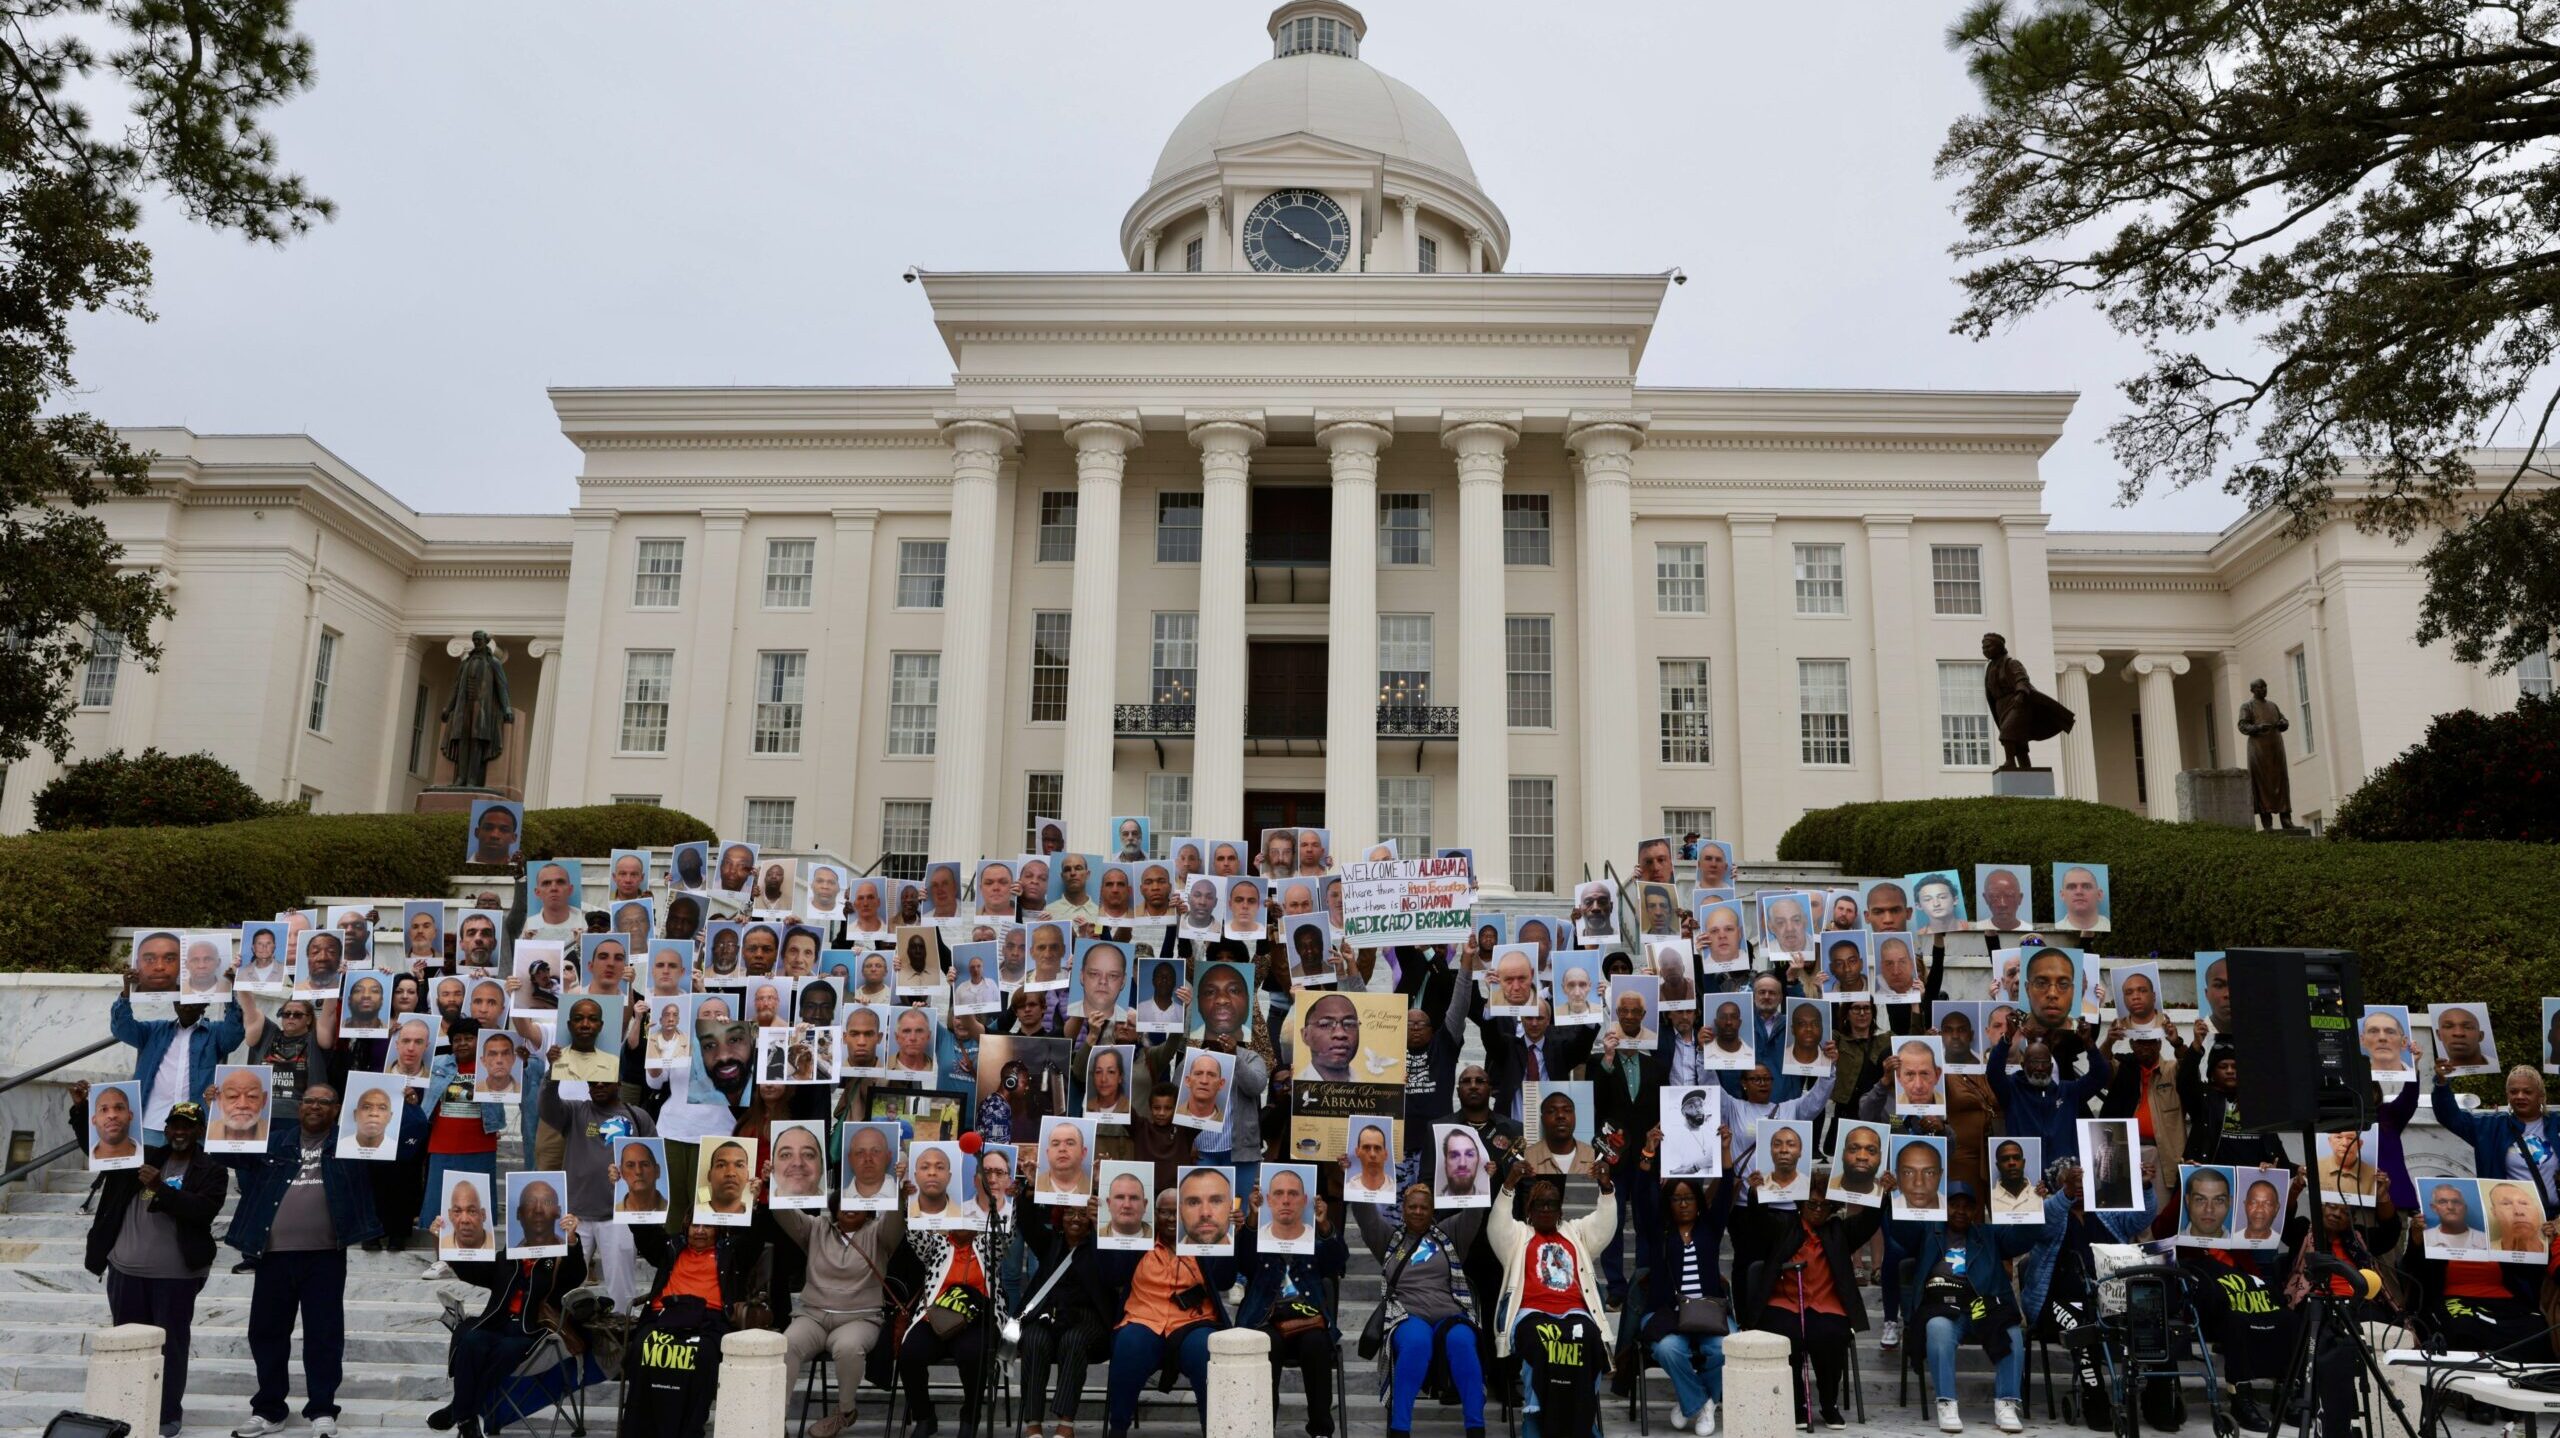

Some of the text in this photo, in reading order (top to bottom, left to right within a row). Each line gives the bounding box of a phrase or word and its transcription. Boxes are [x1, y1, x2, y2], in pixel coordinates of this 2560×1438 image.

[1341, 858, 1467, 881] WELCOME TO ALABAMA
[1400, 883, 1407, 893] is
[1390, 901, 1398, 910] is
[1420, 894, 1453, 910] DAMN
[1344, 908, 1471, 936] MEDICAID EXPANSION
[1378, 1009, 1402, 1022] Loving
[1367, 1021, 1398, 1033] Memory
[272, 1071, 294, 1080] BAMA
[272, 1079, 294, 1087] UTION
[1320, 1084, 1356, 1096] Roderick
[1320, 1095, 1376, 1109] ABRAMS
[2217, 1273, 2246, 1295] NO
[1535, 1323, 1562, 1341] NO
[2081, 1367, 2098, 1387] UP
